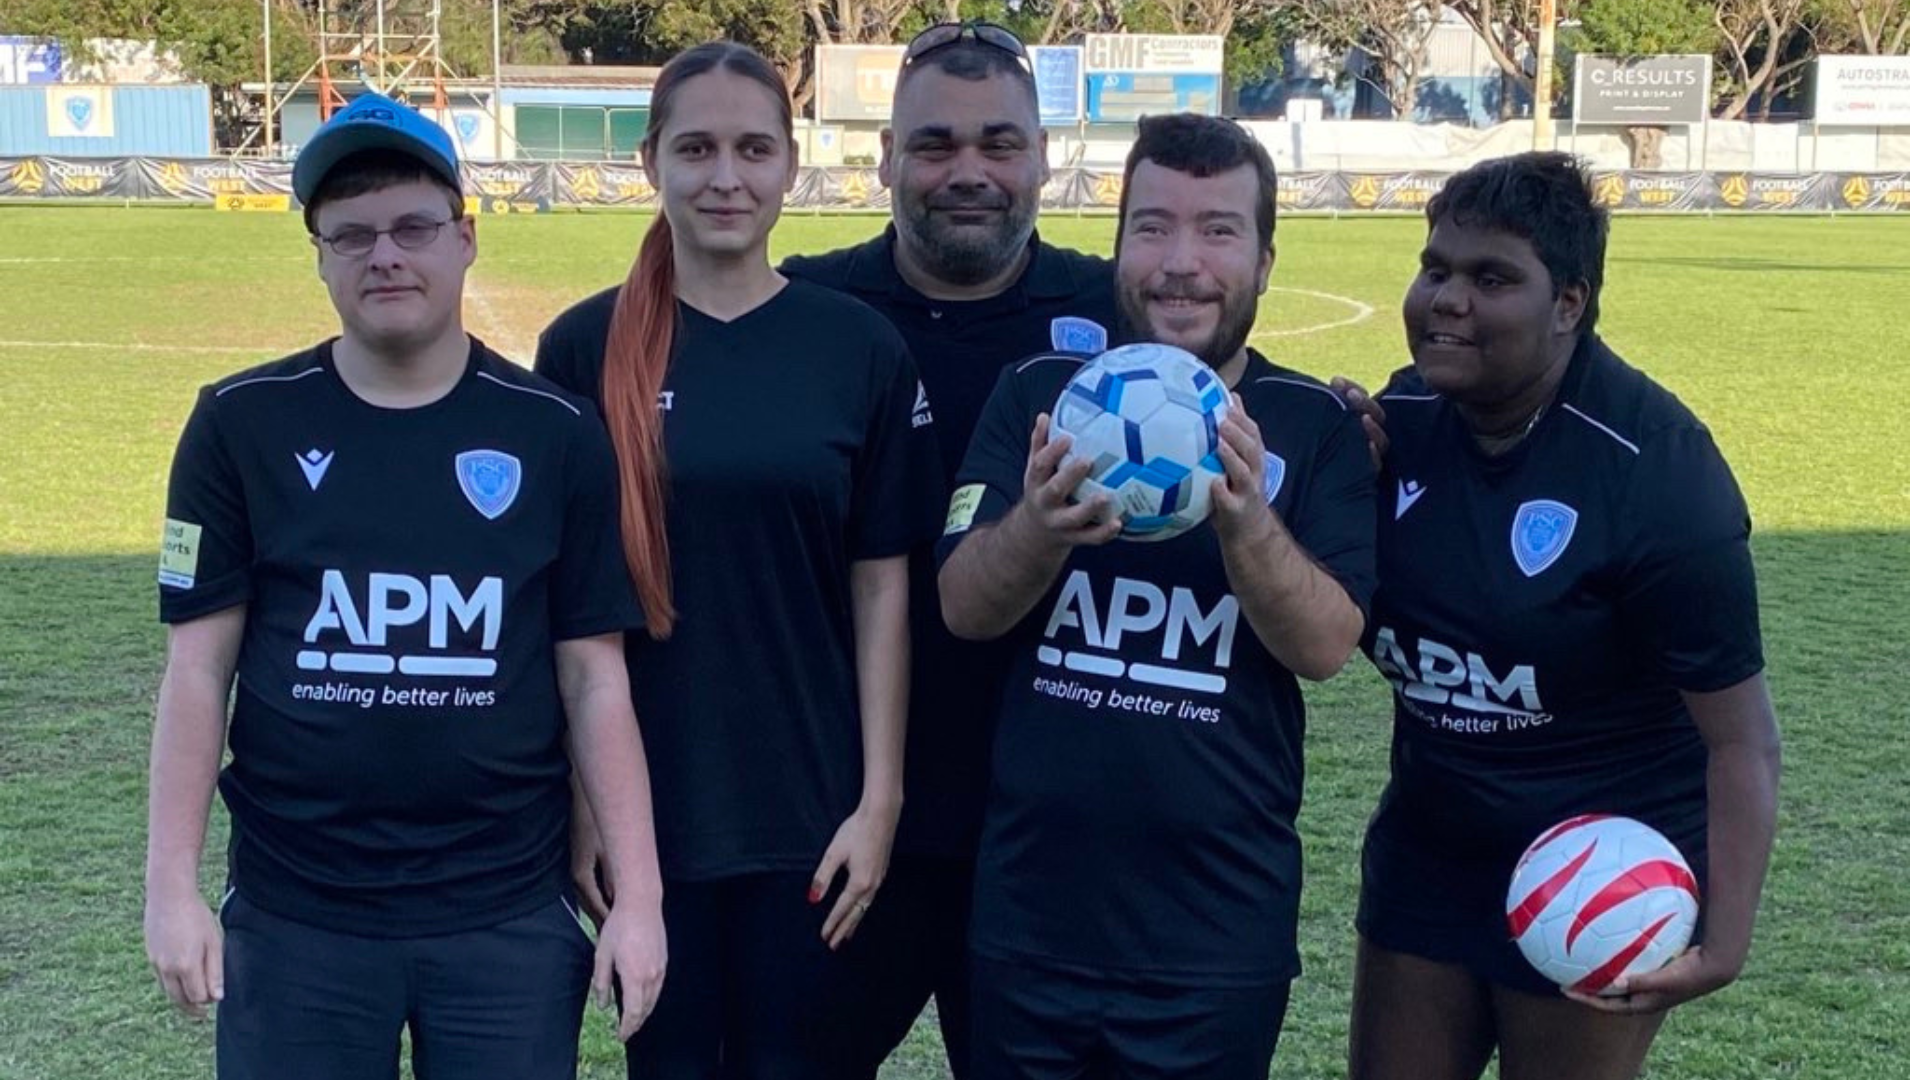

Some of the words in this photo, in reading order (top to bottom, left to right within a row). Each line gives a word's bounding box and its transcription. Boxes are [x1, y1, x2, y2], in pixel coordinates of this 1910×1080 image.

[1089, 36, 1149, 68] GMF
[1599, 90, 1629, 99] PRINT
[1643, 90, 1685, 99] DISPLAY
[50, 166, 114, 177] FOOTBALL
[1629, 179, 1687, 190] FOOTBALL
[1640, 191, 1676, 203] WEST
[304, 568, 503, 650] APM
[1044, 569, 1239, 668] APM
[292, 682, 375, 708] enabling
[382, 684, 449, 706] better
[454, 686, 495, 706] lives
[1033, 676, 1103, 708] enabling
[1107, 688, 1174, 715] better
[1178, 699, 1221, 723] lives
